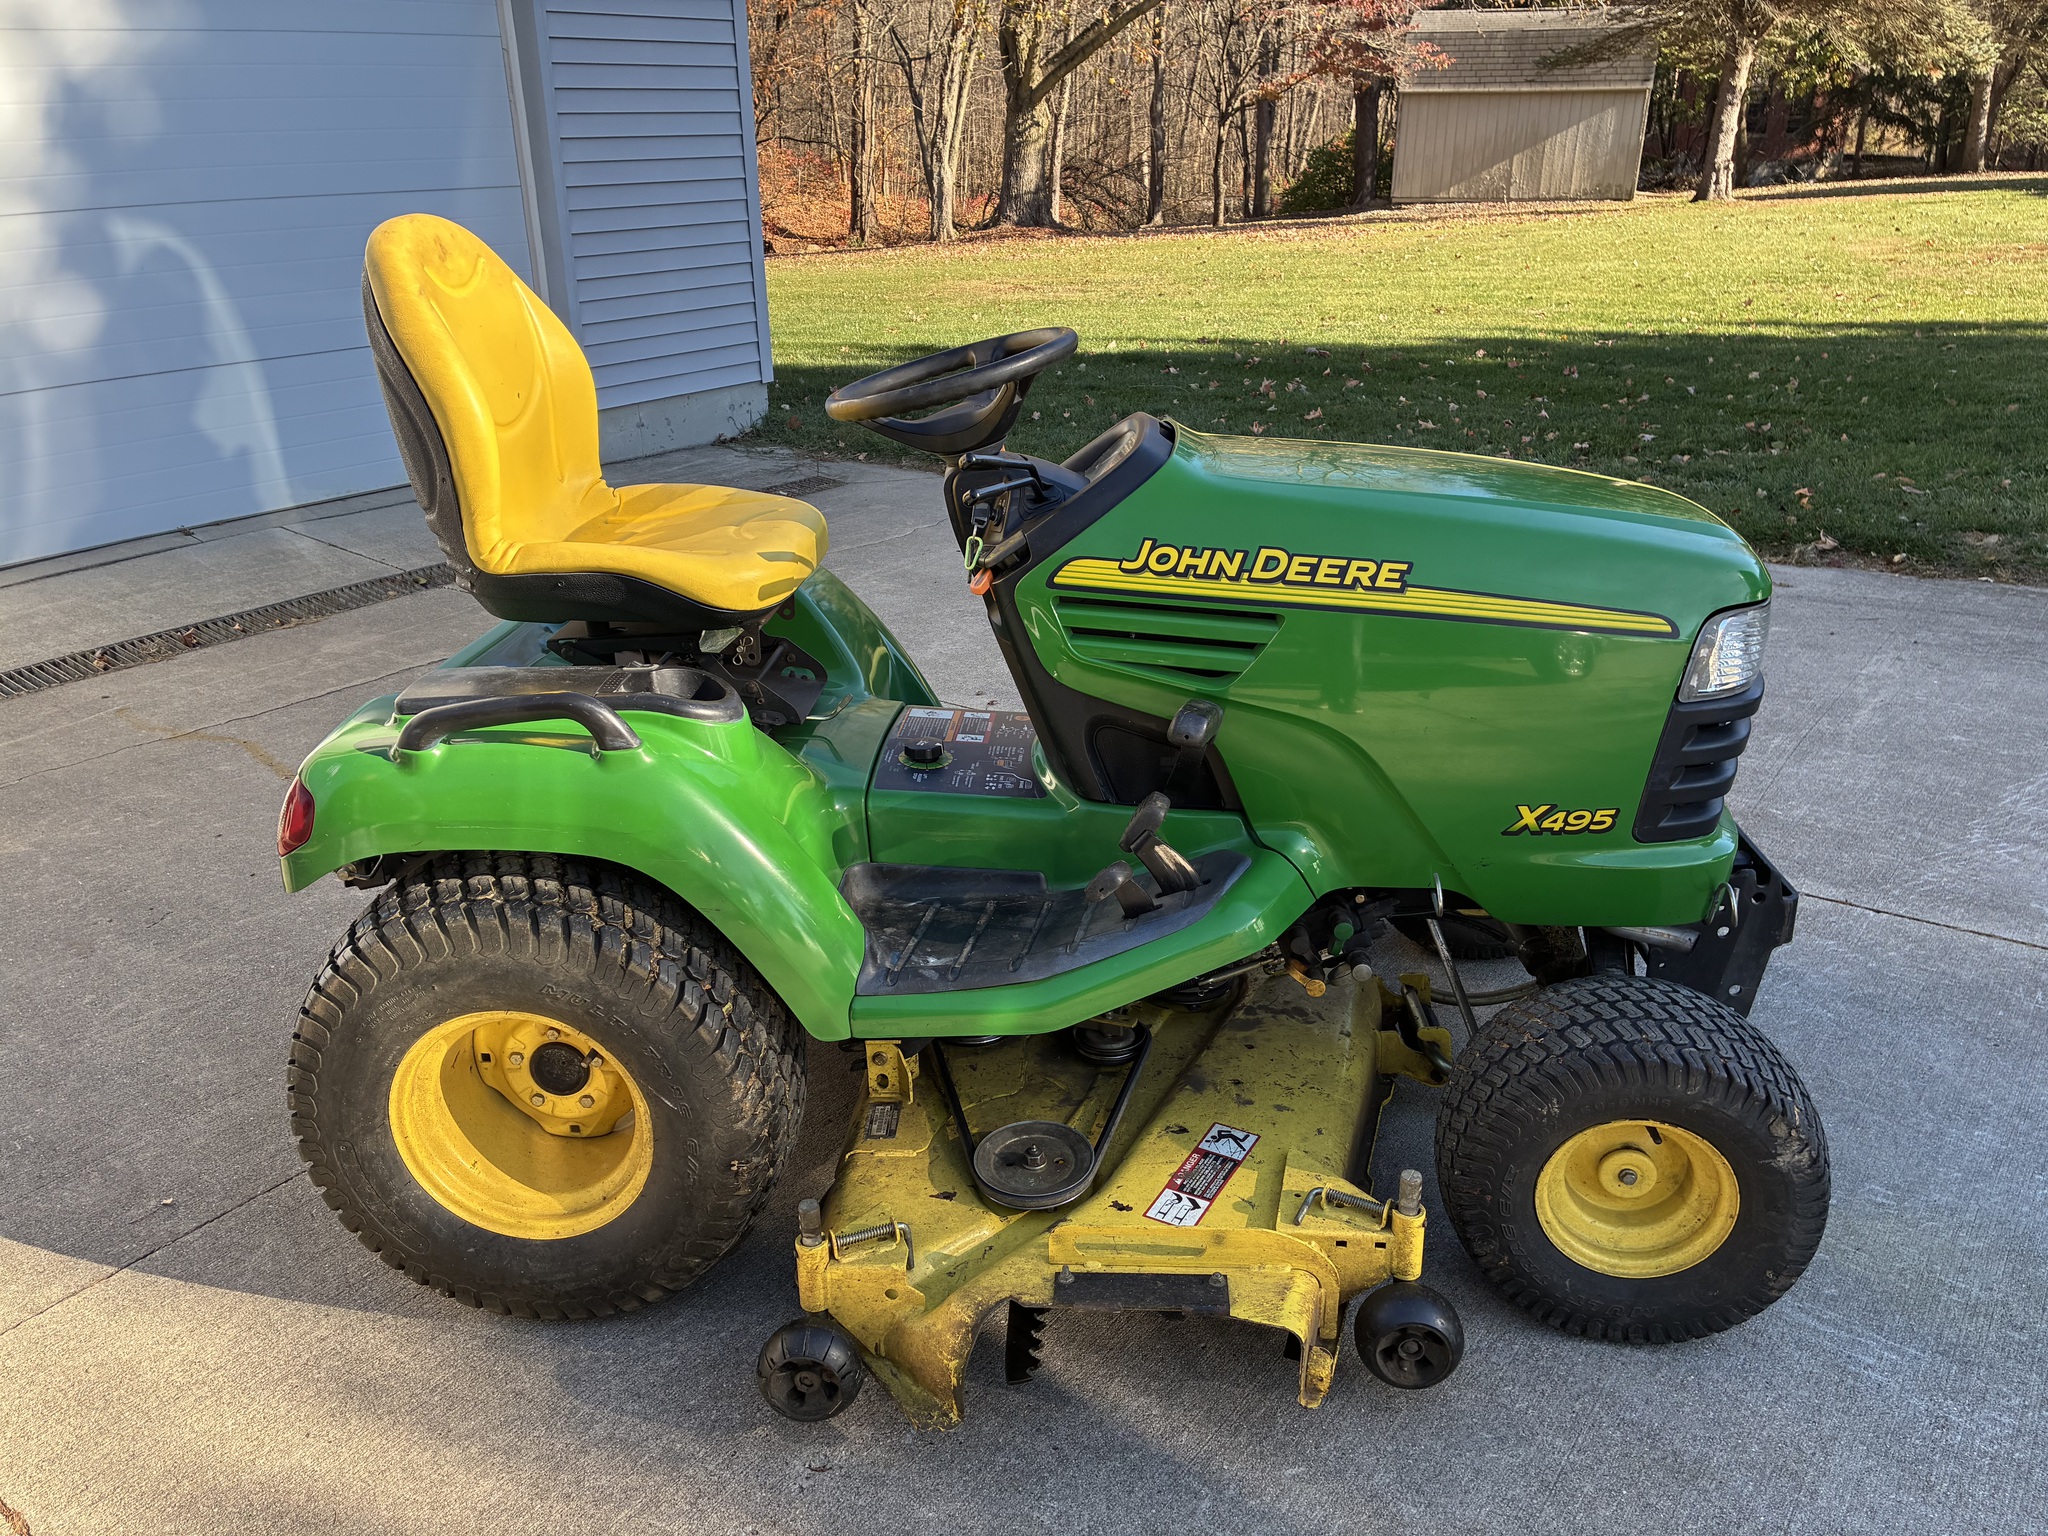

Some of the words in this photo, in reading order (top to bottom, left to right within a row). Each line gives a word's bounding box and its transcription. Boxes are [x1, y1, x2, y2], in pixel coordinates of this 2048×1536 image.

[1119, 538, 1246, 582] JOHN
[1248, 546, 1413, 593] DEERE
[1501, 804, 1620, 836] X495
[538, 983, 638, 1037] MULTI
